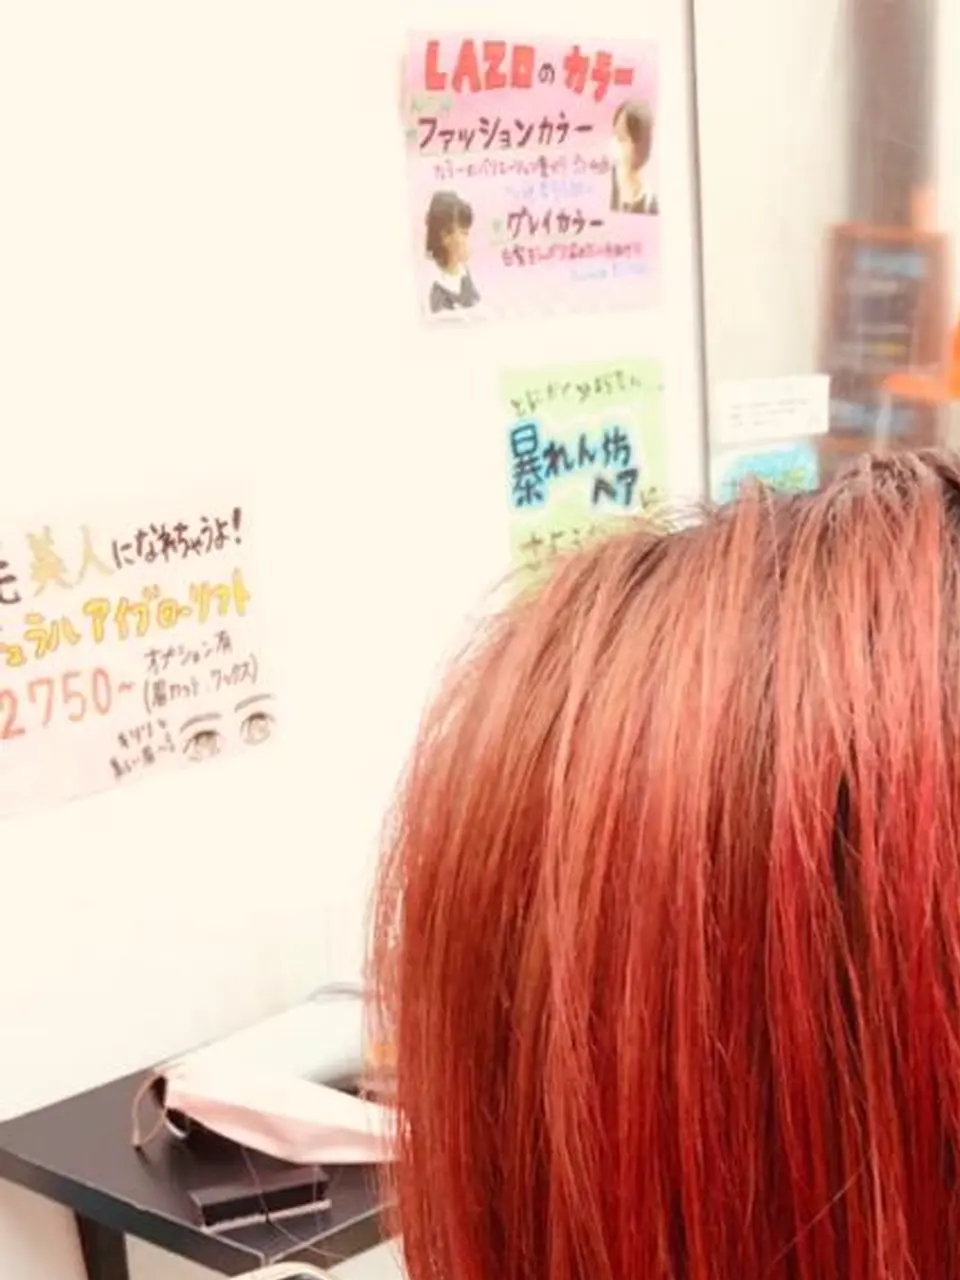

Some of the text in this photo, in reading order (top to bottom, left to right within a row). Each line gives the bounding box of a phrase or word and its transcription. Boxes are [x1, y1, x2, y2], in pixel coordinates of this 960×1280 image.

[418, 111, 594, 151] ファッションカラー
